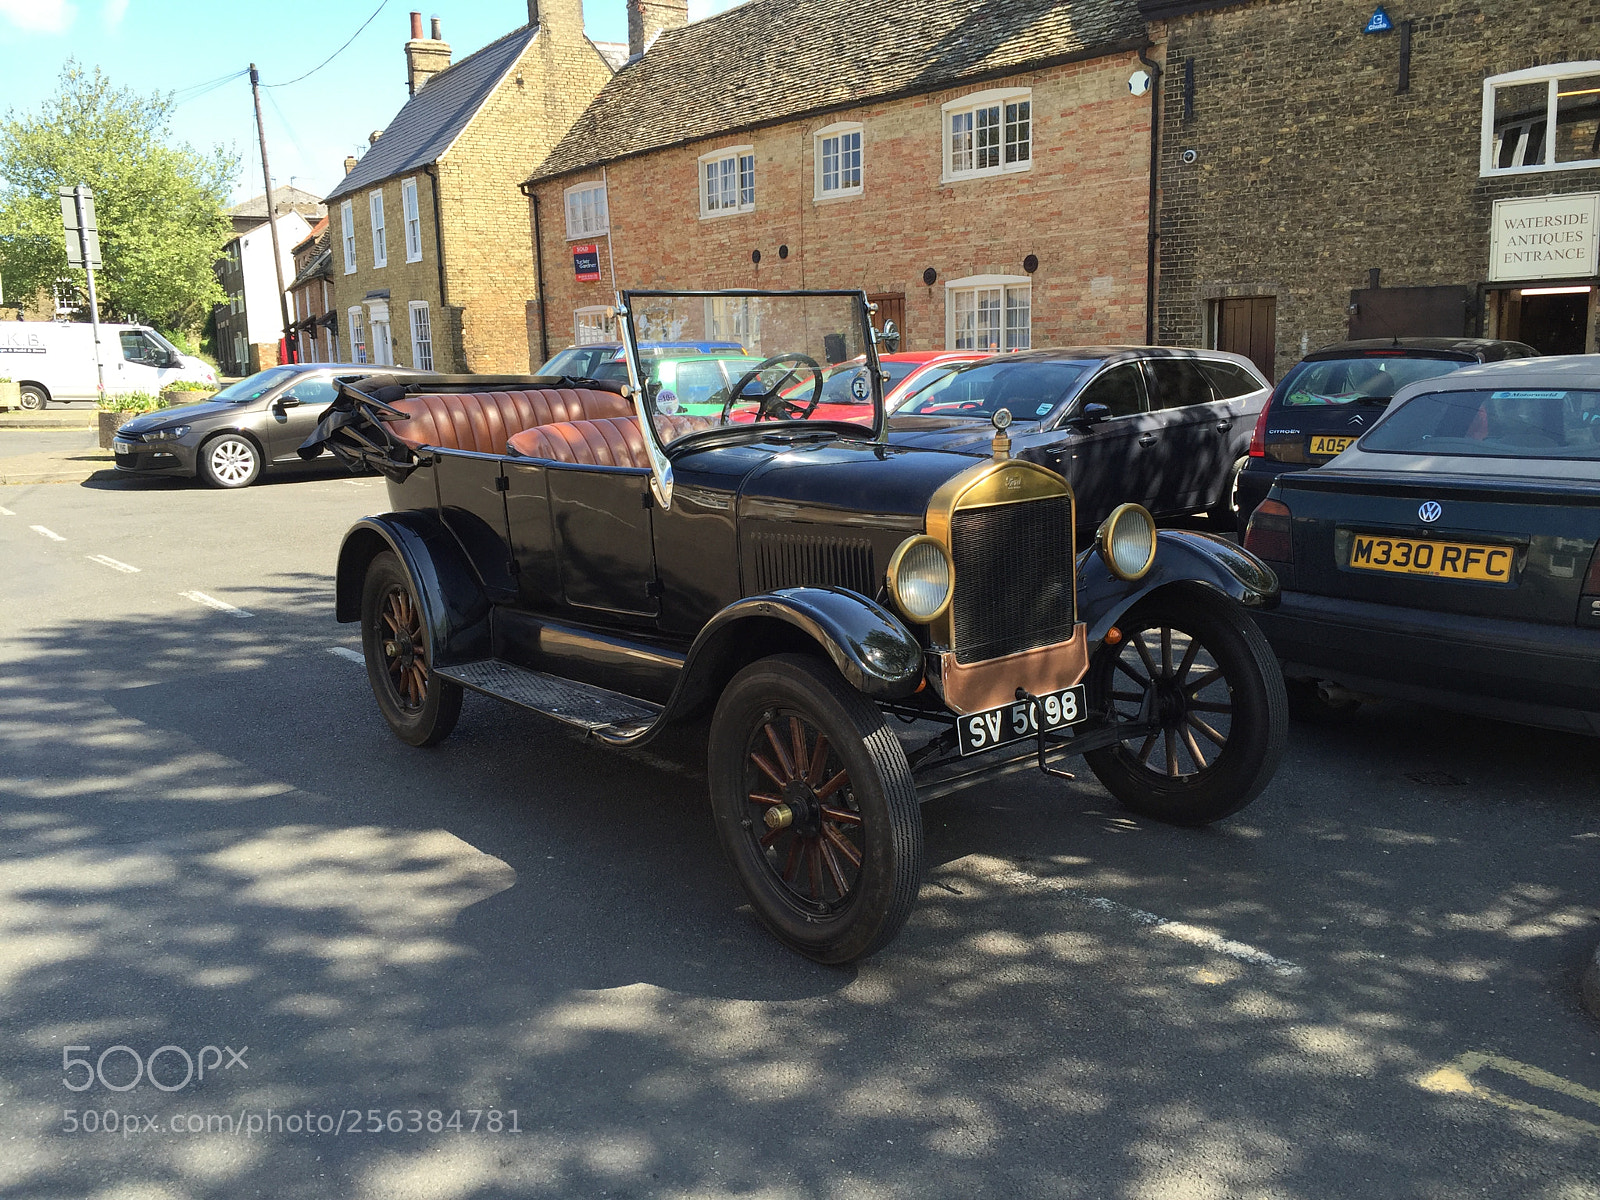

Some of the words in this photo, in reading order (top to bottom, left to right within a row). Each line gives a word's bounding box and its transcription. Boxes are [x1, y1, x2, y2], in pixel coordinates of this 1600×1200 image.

[1504, 213, 1589, 229] WATERSIDE
[1507, 231, 1583, 246] ANTIQUES
[1504, 248, 1585, 263] ENTRANCE
[1353, 539, 1434, 569] M330
[1440, 546, 1508, 576] RFC
[969, 710, 1002, 748] SV
